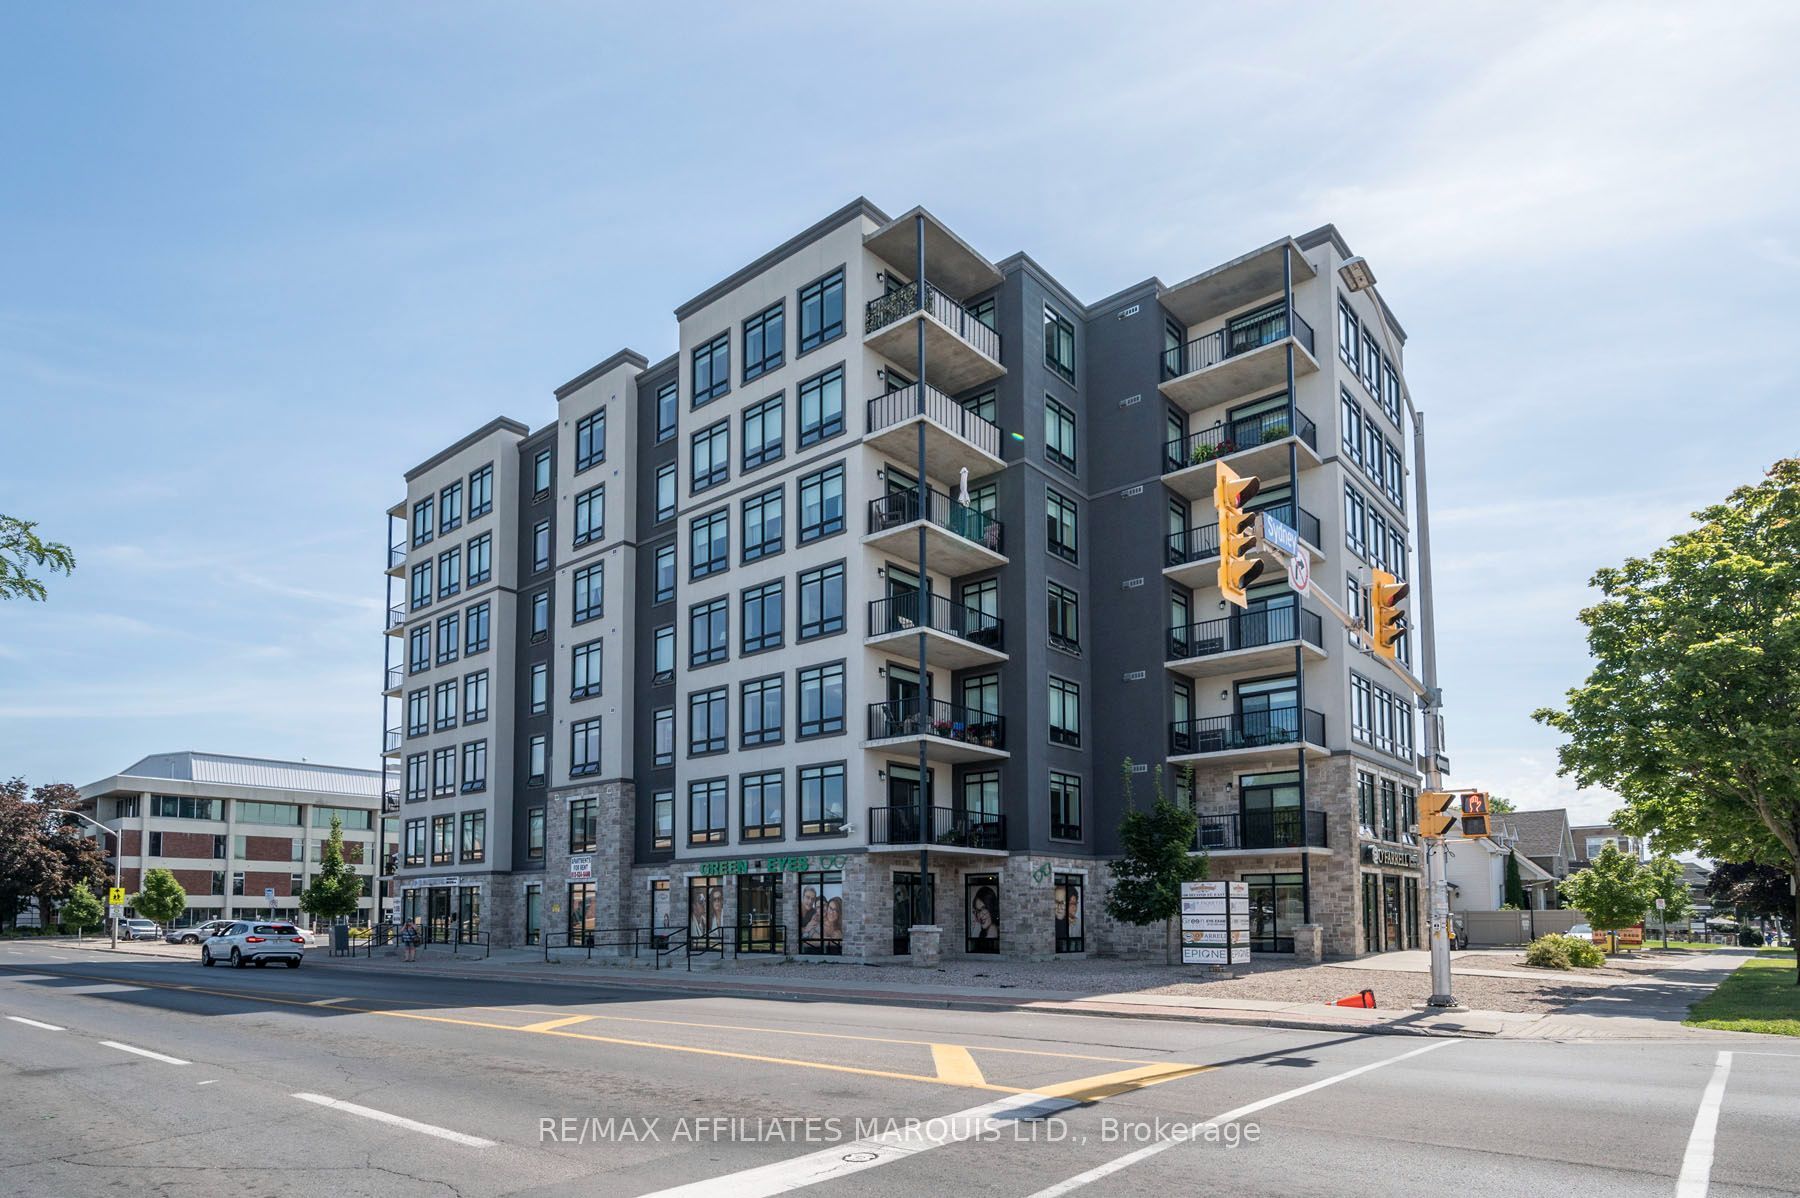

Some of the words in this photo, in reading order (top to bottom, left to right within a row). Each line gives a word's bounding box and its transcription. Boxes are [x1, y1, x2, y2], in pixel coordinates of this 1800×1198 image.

[1267, 515, 1297, 554] Sydney
[699, 859, 749, 875] GREEN
[767, 856, 809, 872] EYES
[1184, 949, 1227, 959] EPIONE
